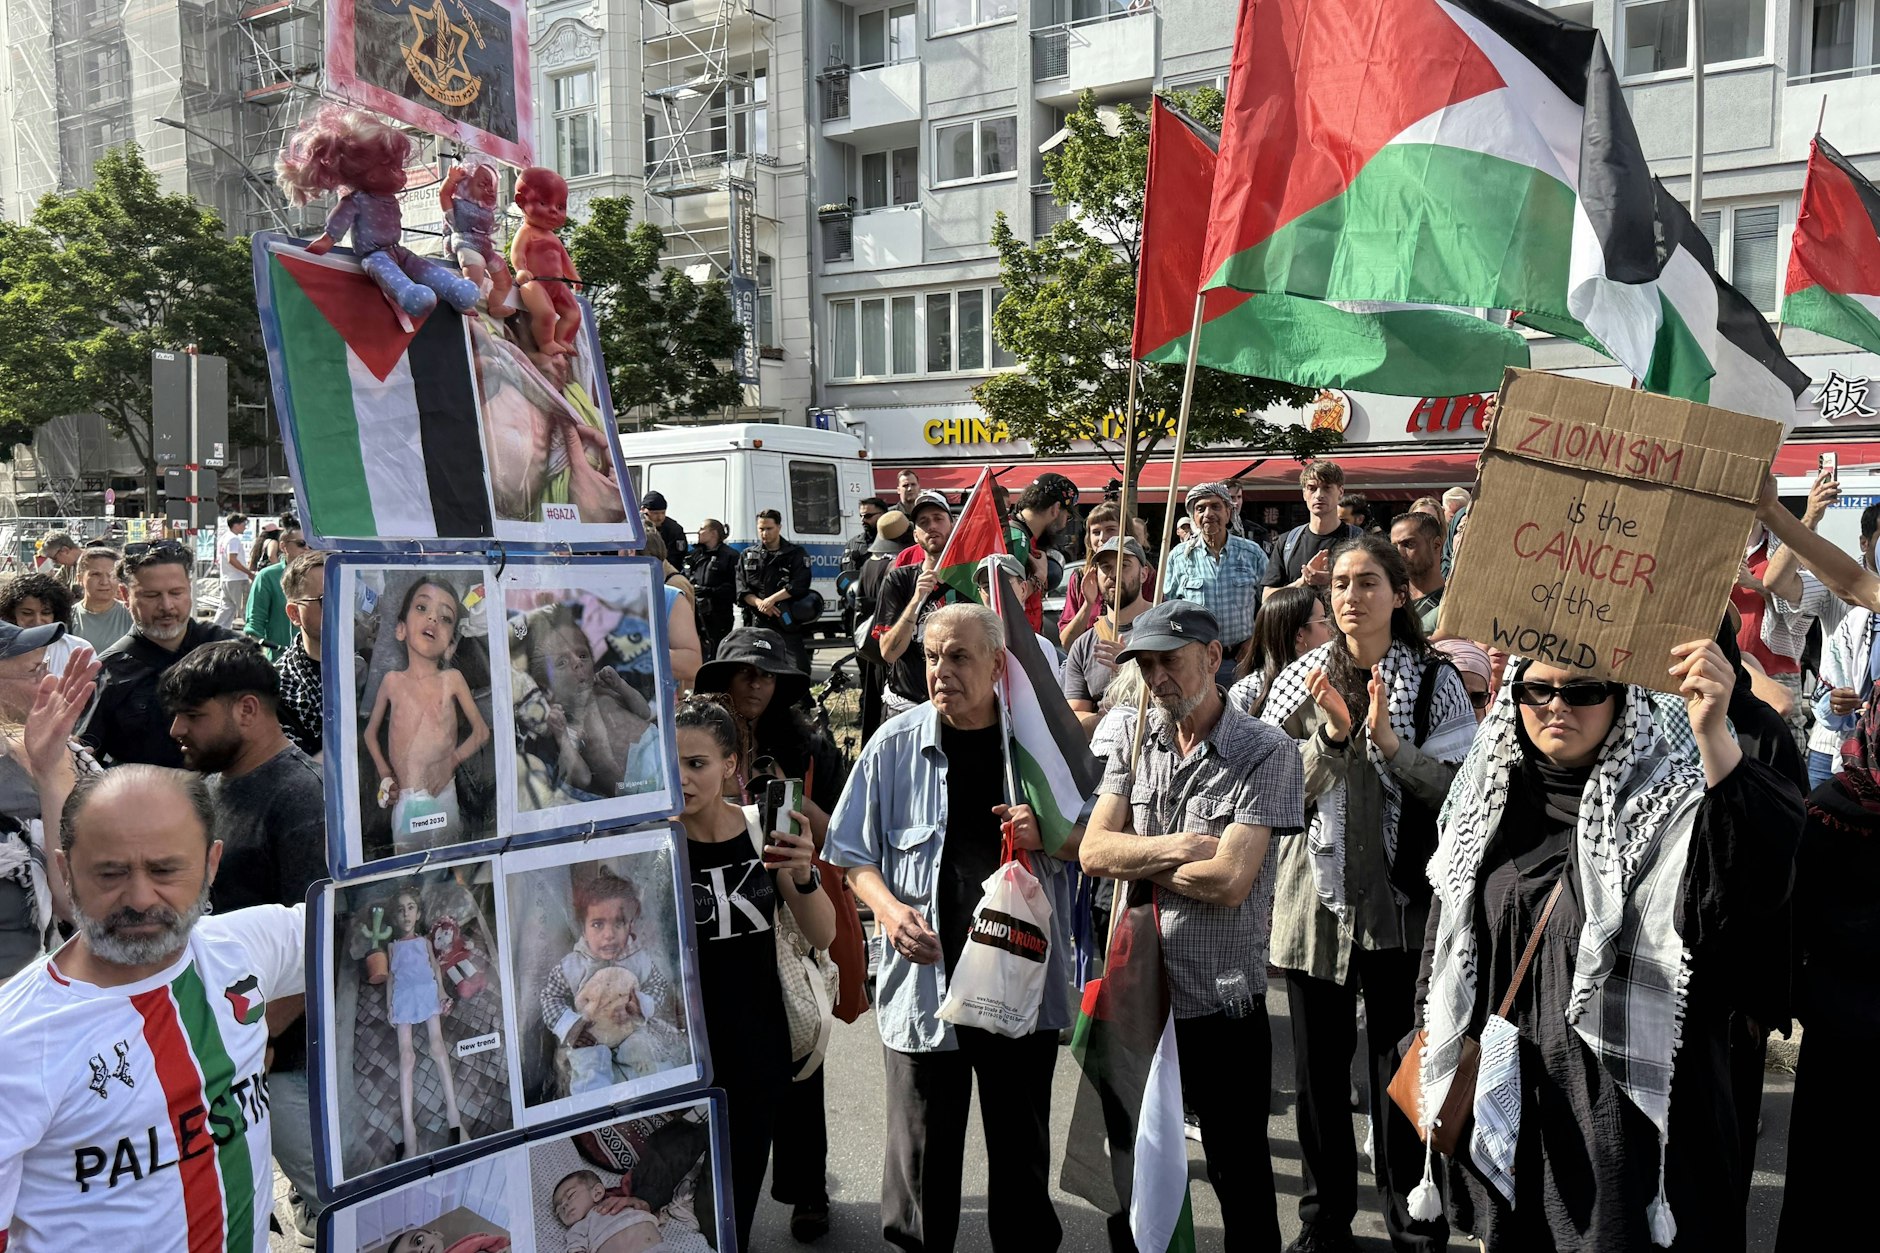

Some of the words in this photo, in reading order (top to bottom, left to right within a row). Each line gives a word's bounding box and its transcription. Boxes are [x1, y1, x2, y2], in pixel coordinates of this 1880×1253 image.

[743, 291, 754, 378] GERÜSTBAU
[1813, 371, 1877, 417] 飯
[1515, 416, 1684, 481] ZIONISM
[850, 482, 861, 493] 25
[546, 508, 576, 520] #GAZA
[1567, 496, 1587, 524] is
[1598, 500, 1638, 538] the
[1513, 522, 1657, 594] CANCER
[1531, 581, 1562, 612] of
[1564, 585, 1614, 623] the
[1493, 617, 1597, 669] WORLD
[412, 819, 428, 828] Trend
[430, 816, 445, 825] 2030
[460, 1043, 475, 1052] New
[477, 1036, 496, 1048] trend
